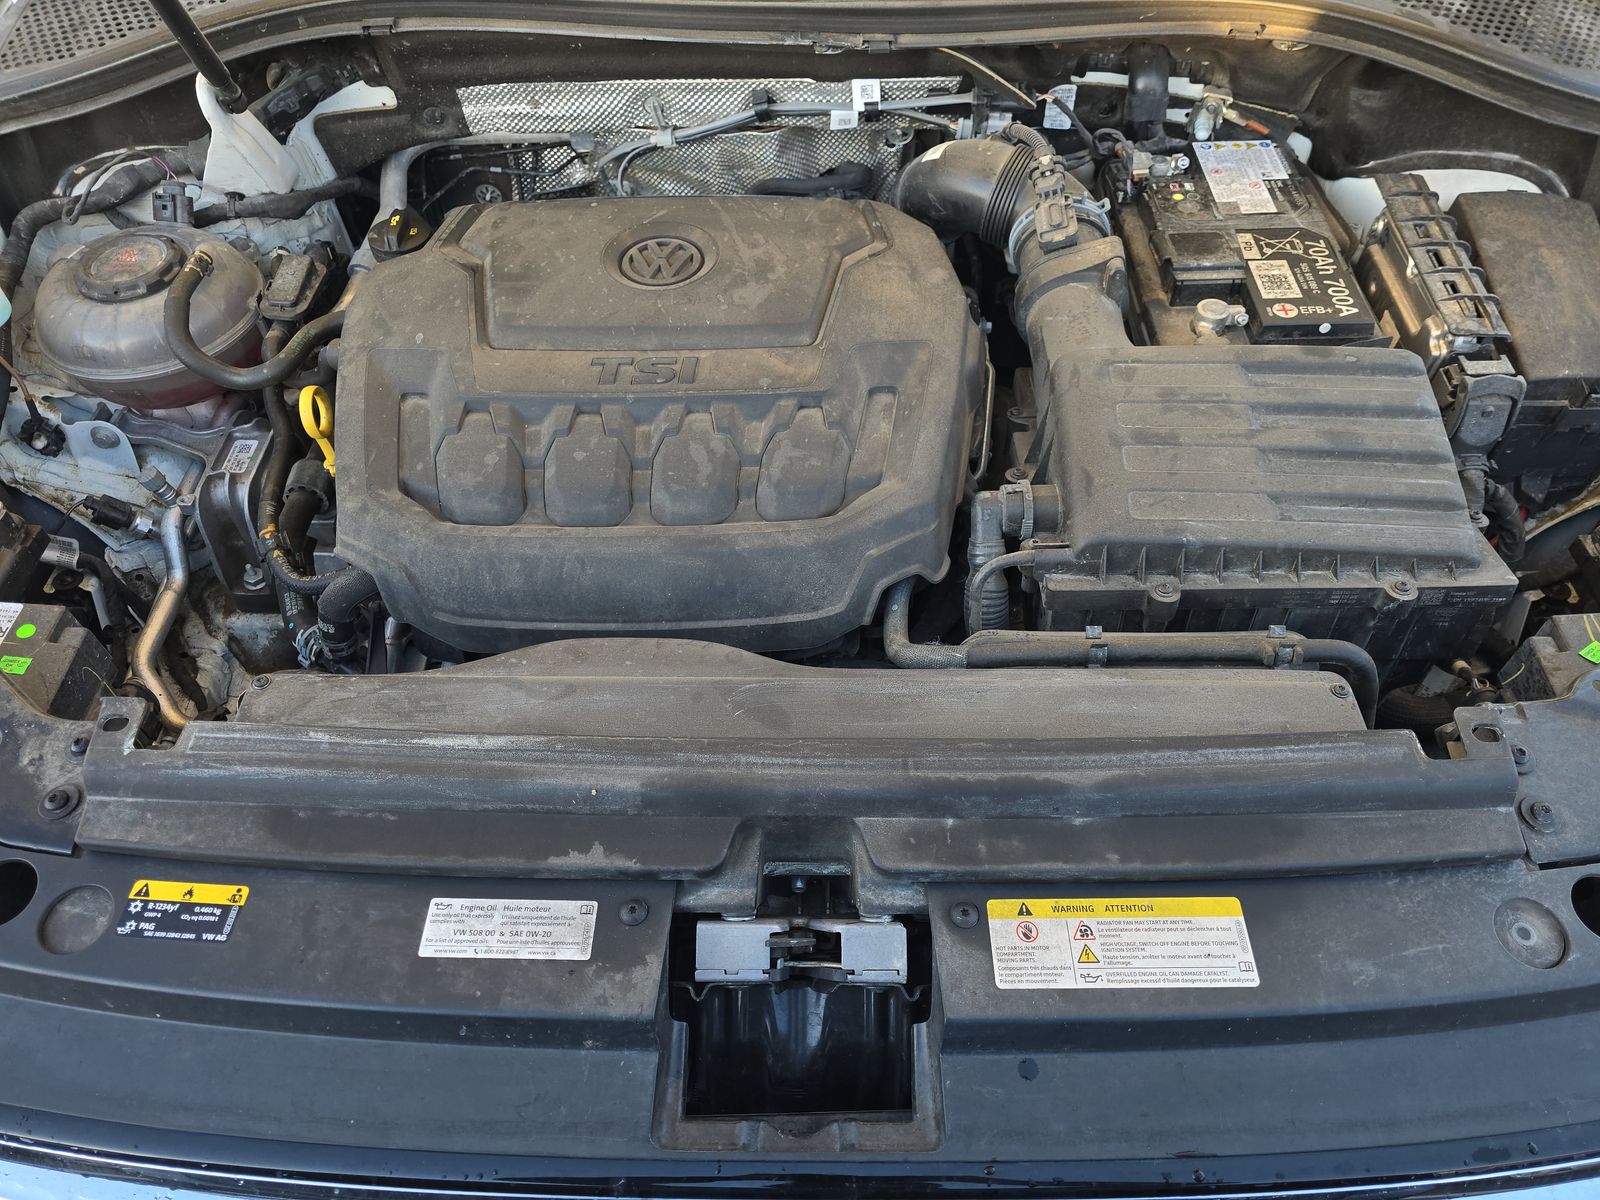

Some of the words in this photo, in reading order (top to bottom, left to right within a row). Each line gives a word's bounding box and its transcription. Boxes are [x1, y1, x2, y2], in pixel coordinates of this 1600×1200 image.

[1304, 239, 1337, 275] 70Ah
[1323, 278, 1359, 317] 700A
[591, 357, 699, 385] TSI
[148, 902, 180, 913] R-1234yf
[460, 904, 485, 913] Engine
[503, 904, 522, 912] Huile
[1051, 905, 1094, 913] WARNING
[1105, 904, 1154, 913] ATTENTION
[139, 922, 156, 930] PAG
